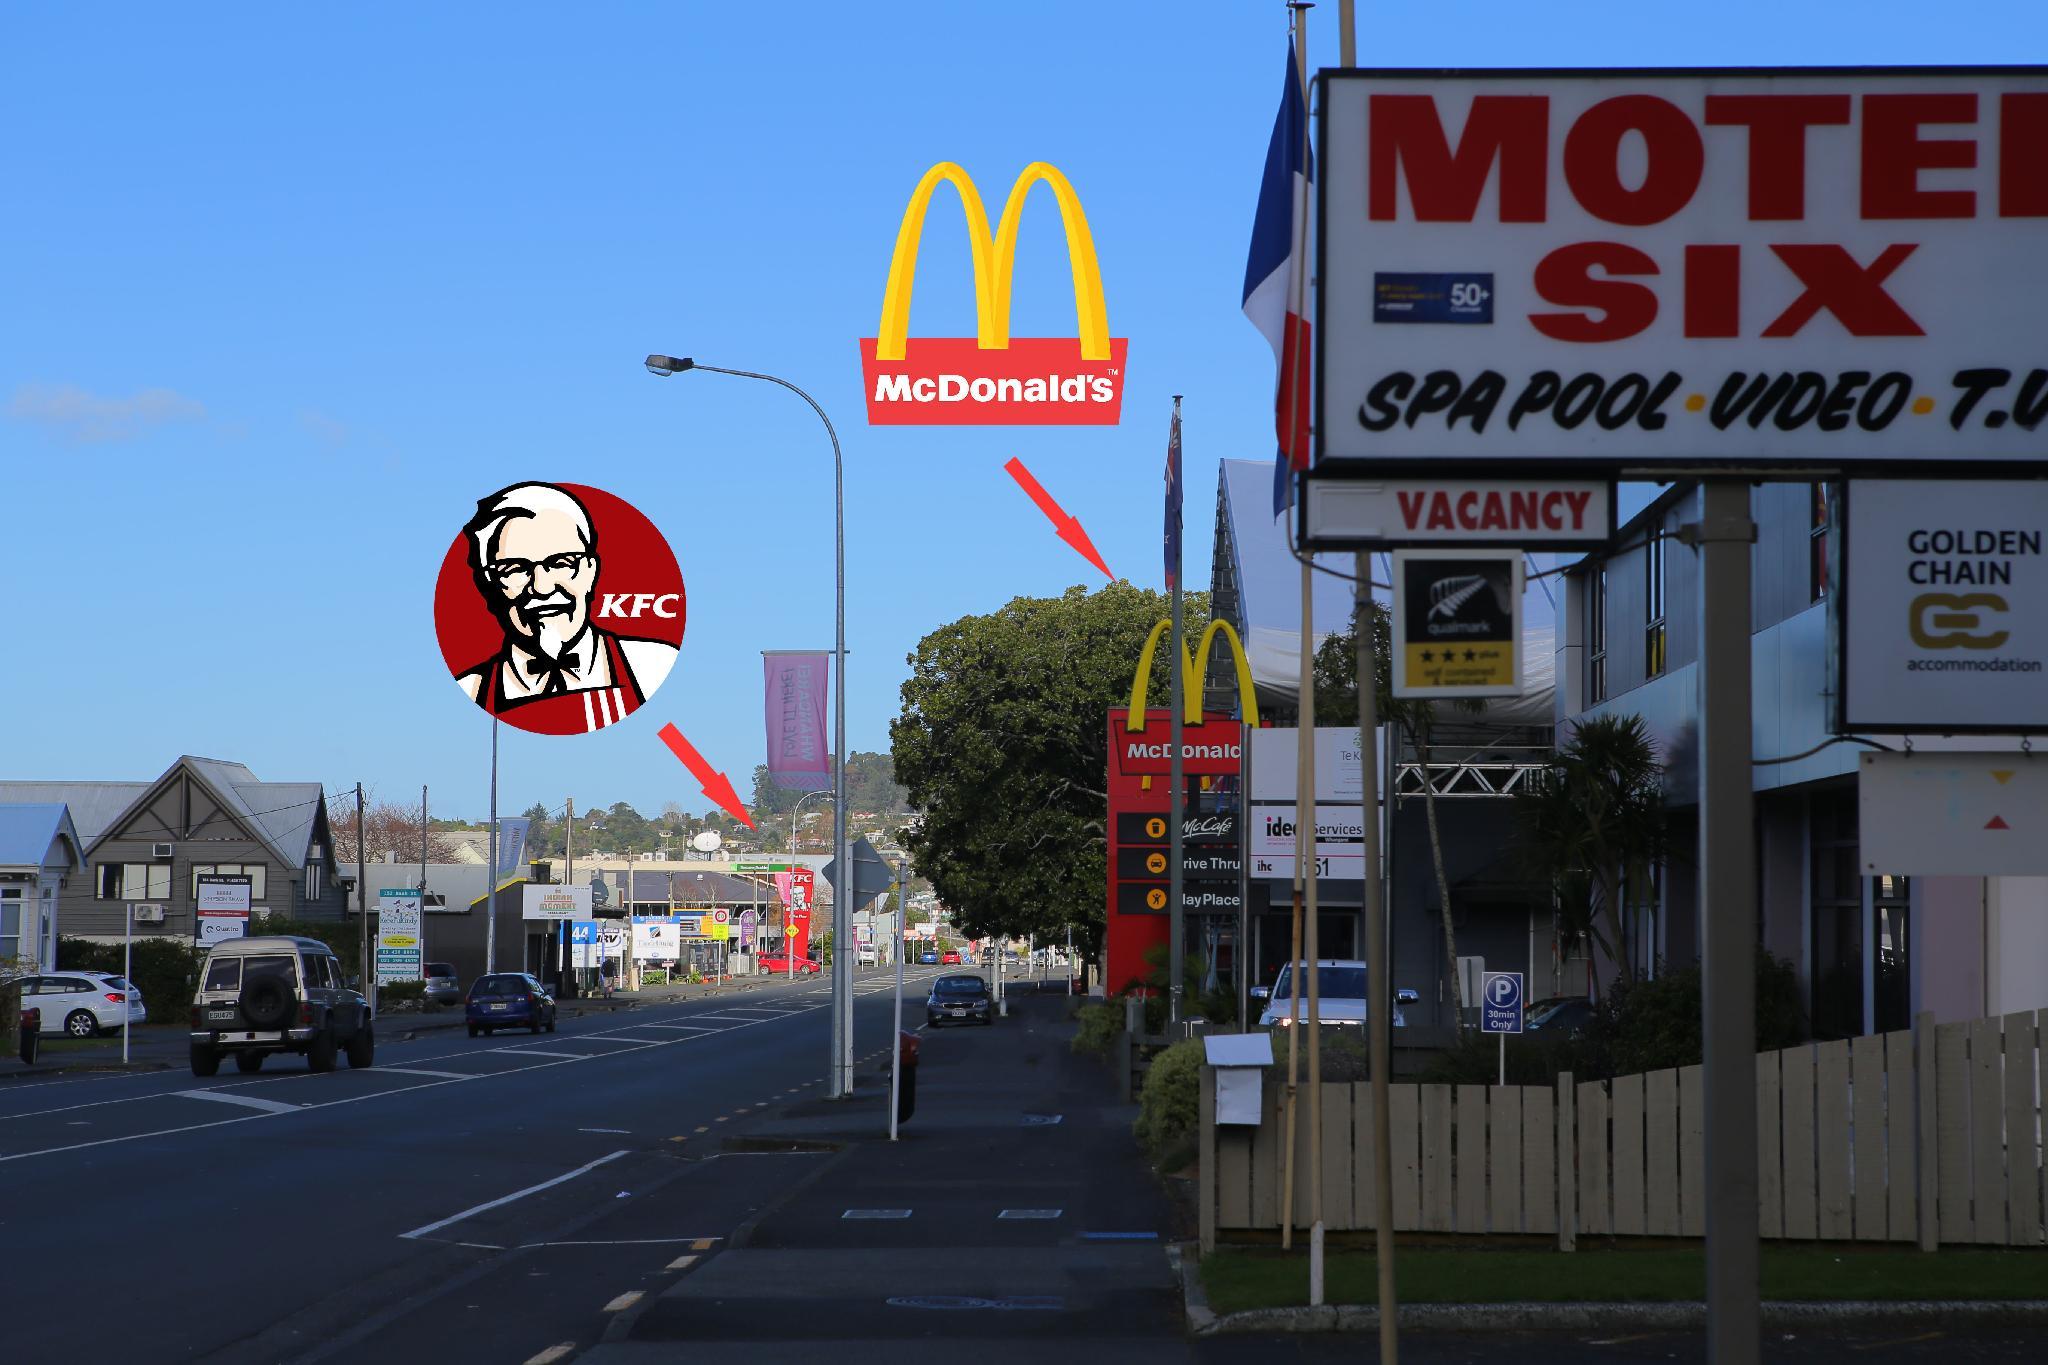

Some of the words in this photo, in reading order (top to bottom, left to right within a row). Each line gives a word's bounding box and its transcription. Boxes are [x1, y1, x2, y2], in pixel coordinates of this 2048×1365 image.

[1450, 282, 1490, 306] 50+
[1527, 241, 1927, 343] SIX
[1358, 370, 1507, 435] SPA
[1508, 371, 1682, 432] POOL
[1709, 371, 1912, 432] VIDEO
[1396, 490, 1592, 531] VACANCY
[1907, 530, 2041, 555] GOLDEN
[1907, 560, 2011, 585] CHAIN
[1427, 620, 1491, 636] qualmark
[1907, 657, 2042, 672] accommodation
[1127, 743, 1240, 760] McDonald
[1340, 750, 1351, 761] Te
[1183, 858, 1207, 869] rive
[1209, 857, 1240, 869] Thru
[1257, 860, 1272, 871] ihc
[1182, 893, 1240, 908] layPlace
[1495, 980, 1512, 1003] P
[1487, 1010, 1516, 1018] 30min
[1490, 1020, 1512, 1030] Only
